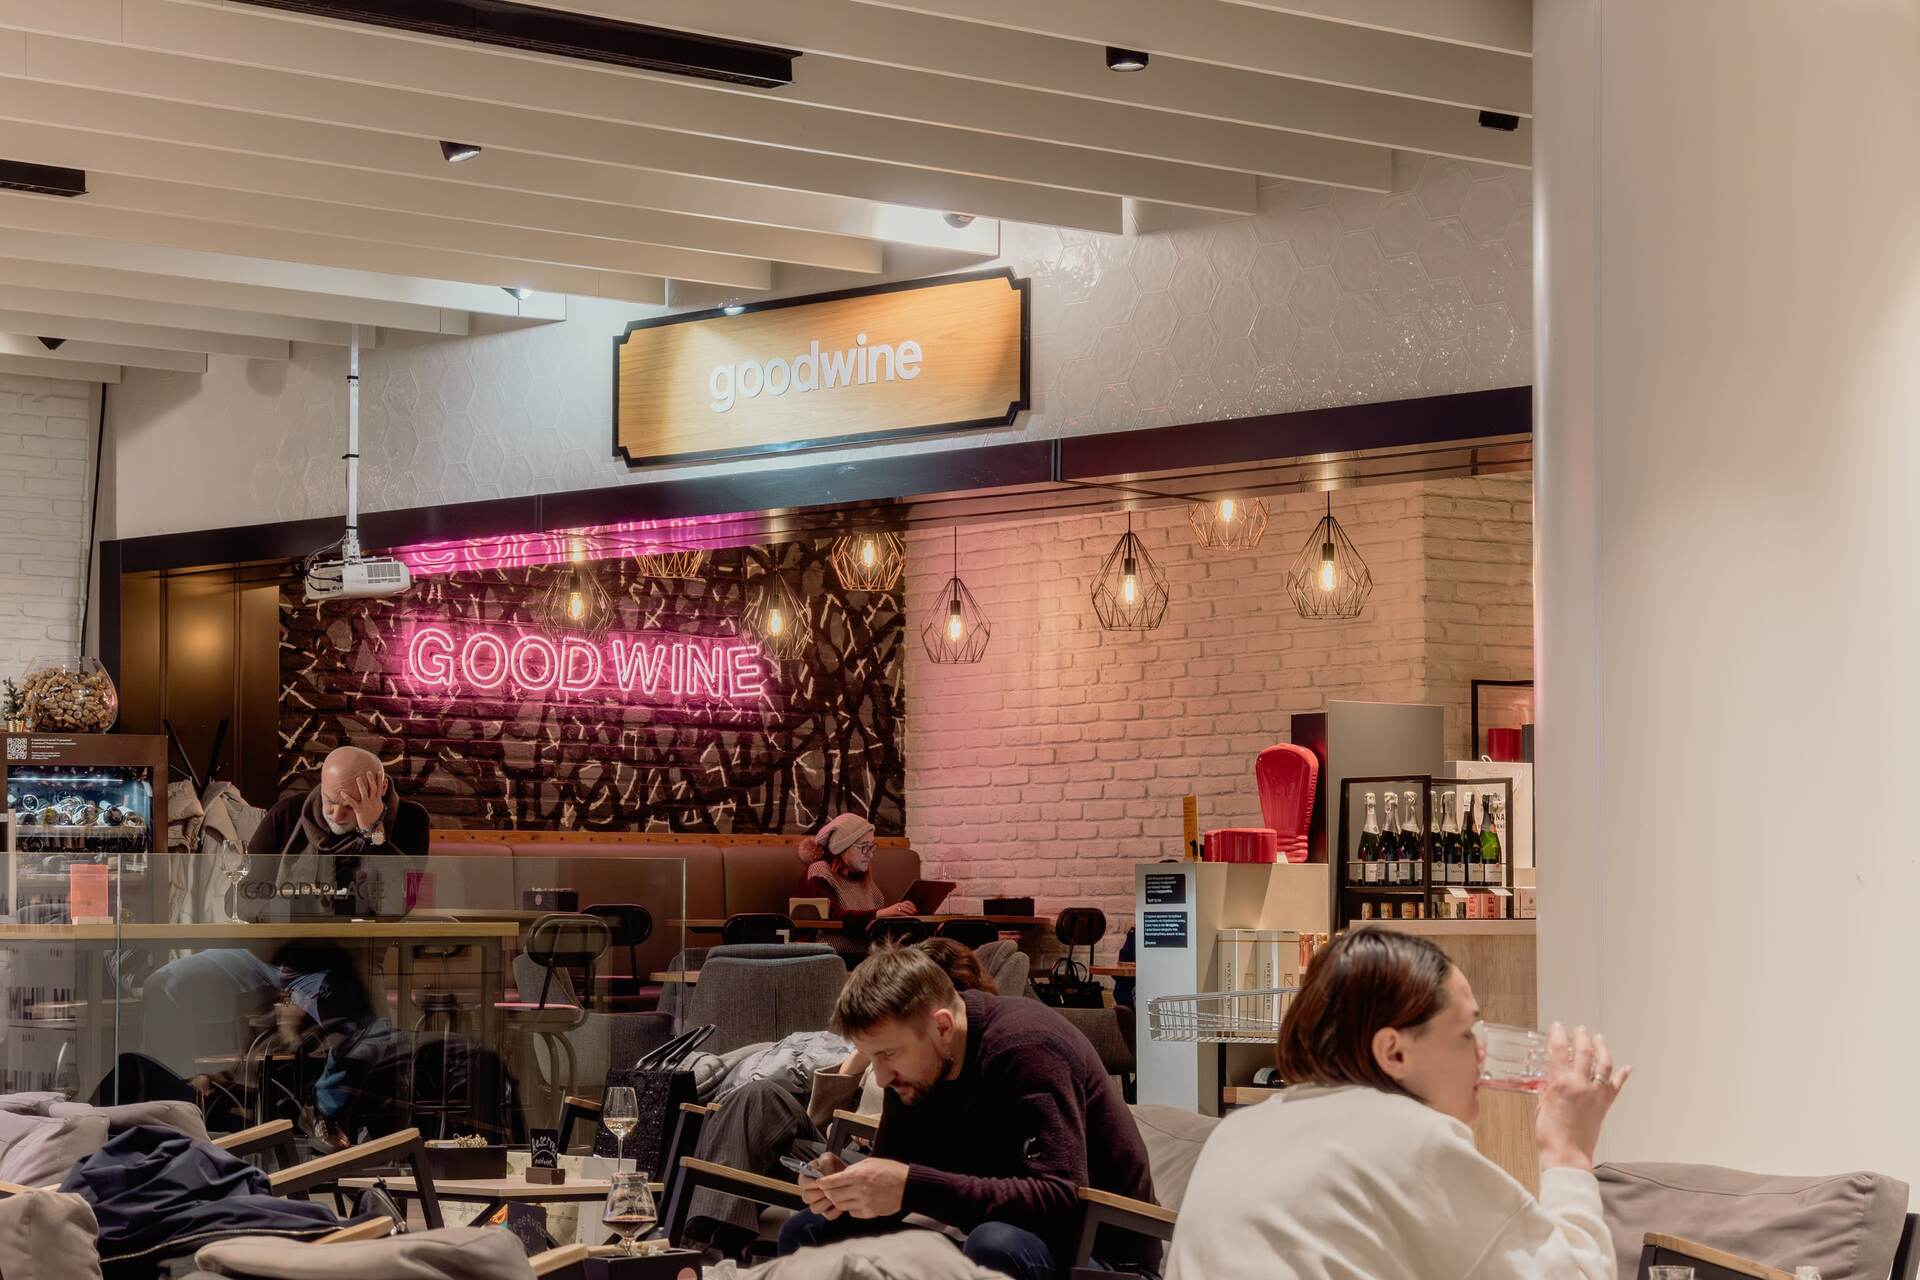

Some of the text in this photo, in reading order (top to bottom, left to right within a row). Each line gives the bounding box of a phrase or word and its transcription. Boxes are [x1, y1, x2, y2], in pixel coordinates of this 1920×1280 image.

[708, 332, 923, 413] goodwine
[408, 626, 764, 699] GOOD WINE
